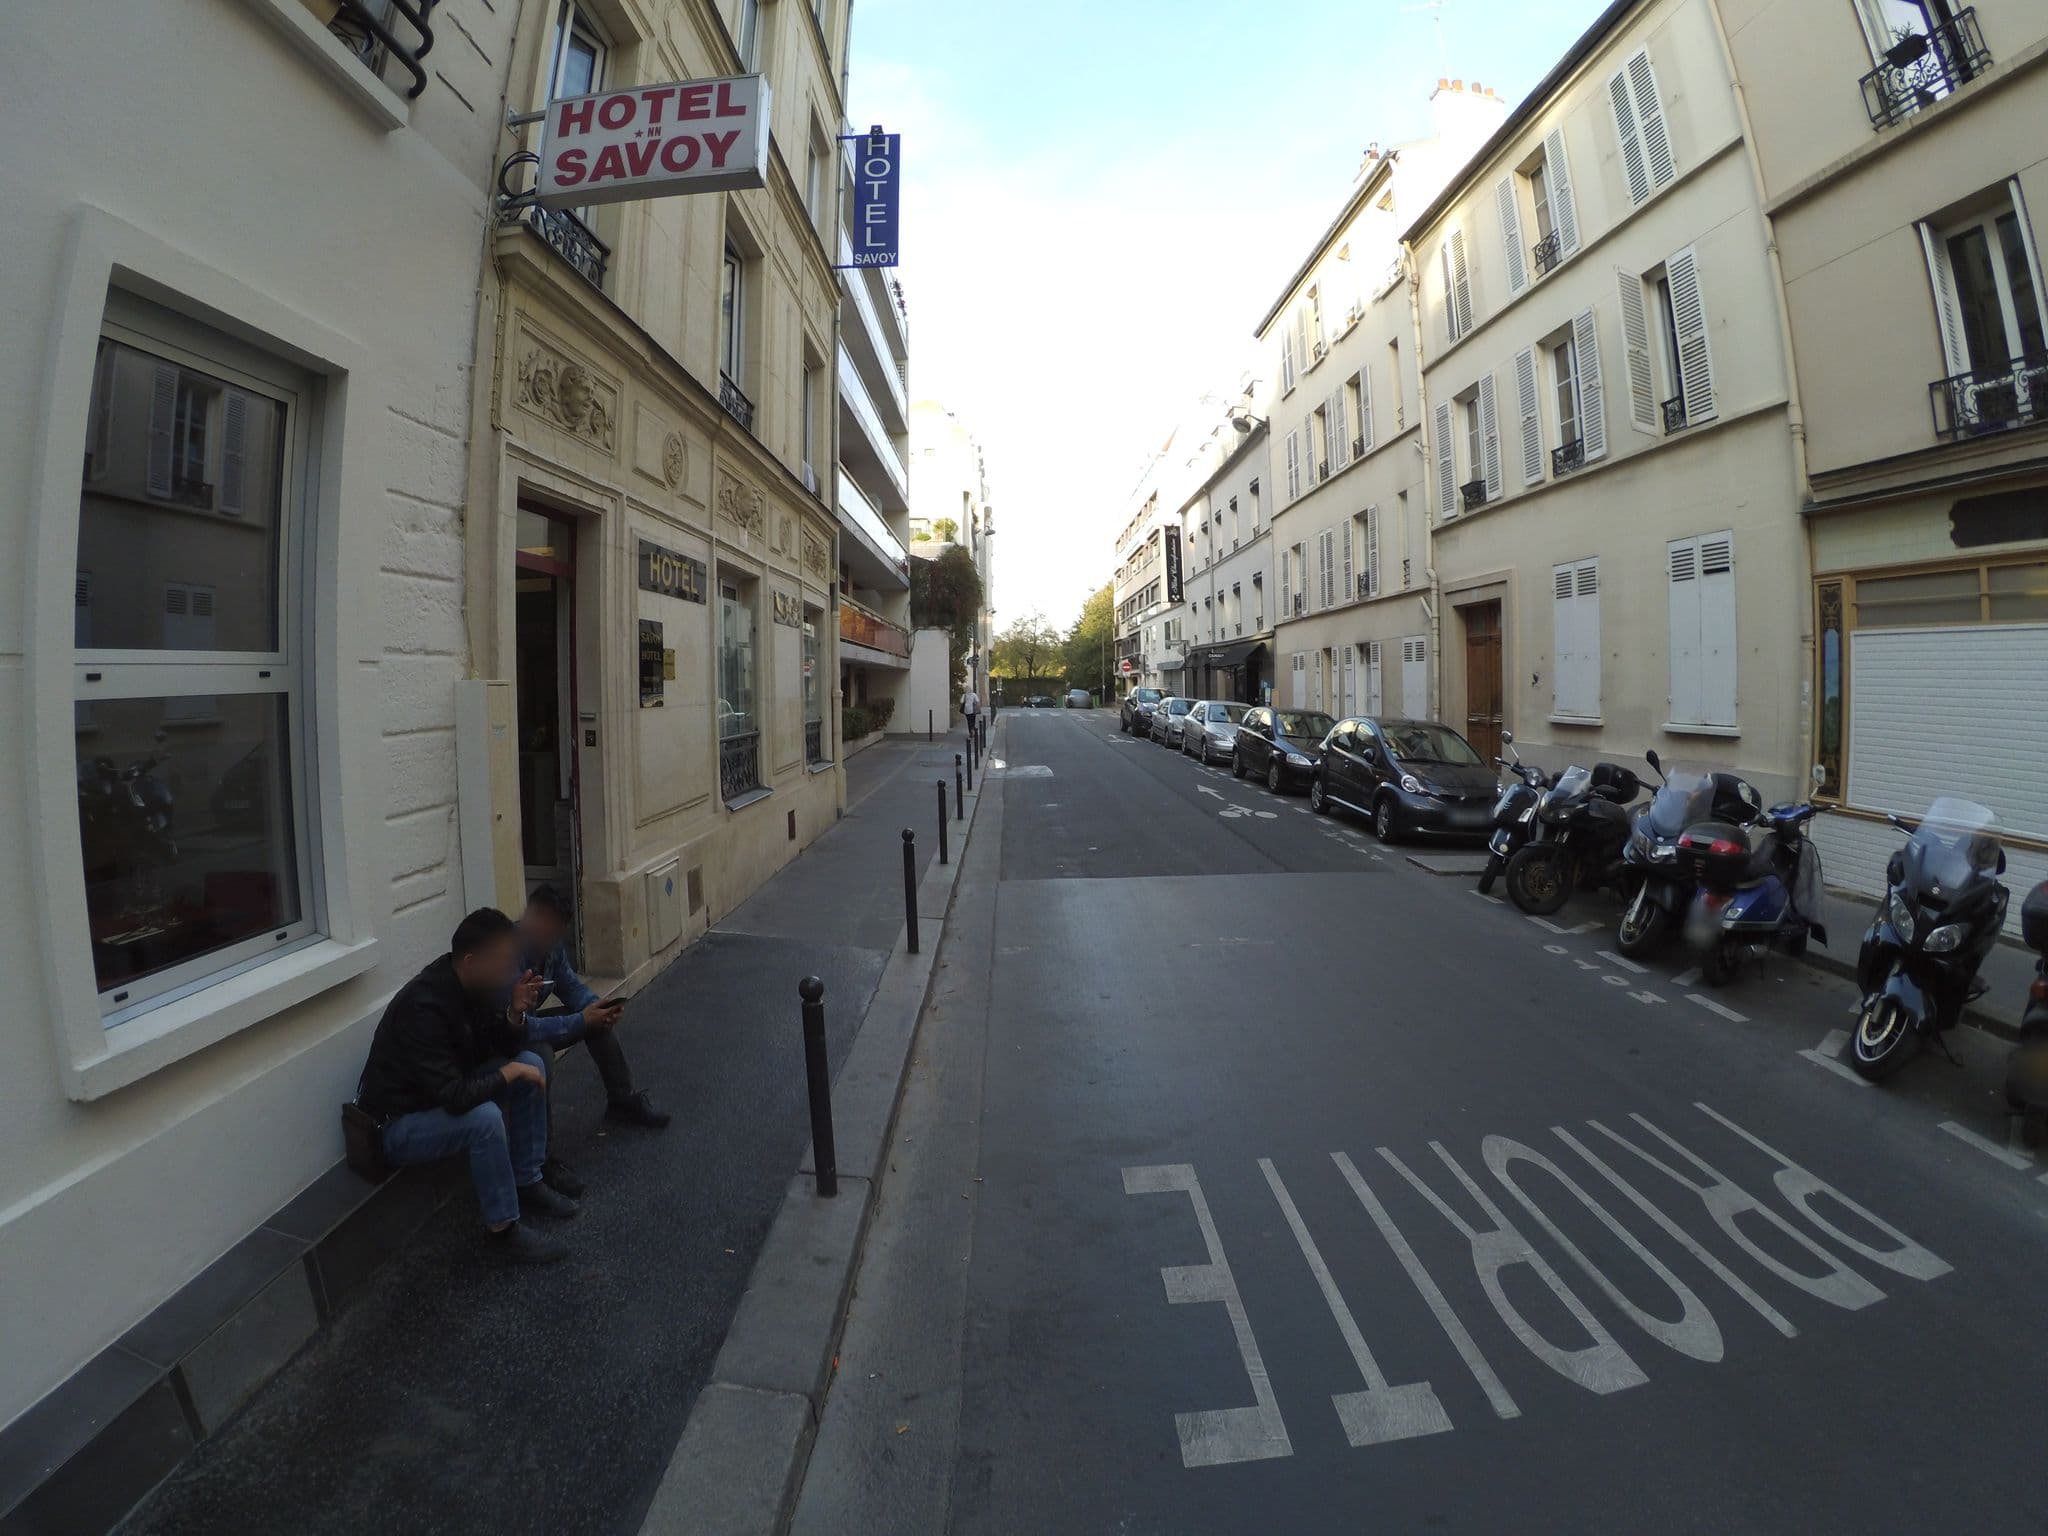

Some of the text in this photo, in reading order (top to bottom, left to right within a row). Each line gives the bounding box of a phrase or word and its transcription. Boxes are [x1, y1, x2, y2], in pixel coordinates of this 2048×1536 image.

[557, 83, 747, 138] HOTEL
[647, 126, 662, 138] NN
[553, 130, 741, 187] SAVOY
[864, 136, 891, 247] HOTEL
[854, 252, 897, 265] SAVOY
[649, 552, 699, 594] HOTEL
[1121, 1101, 1954, 1468] PRIORITE
